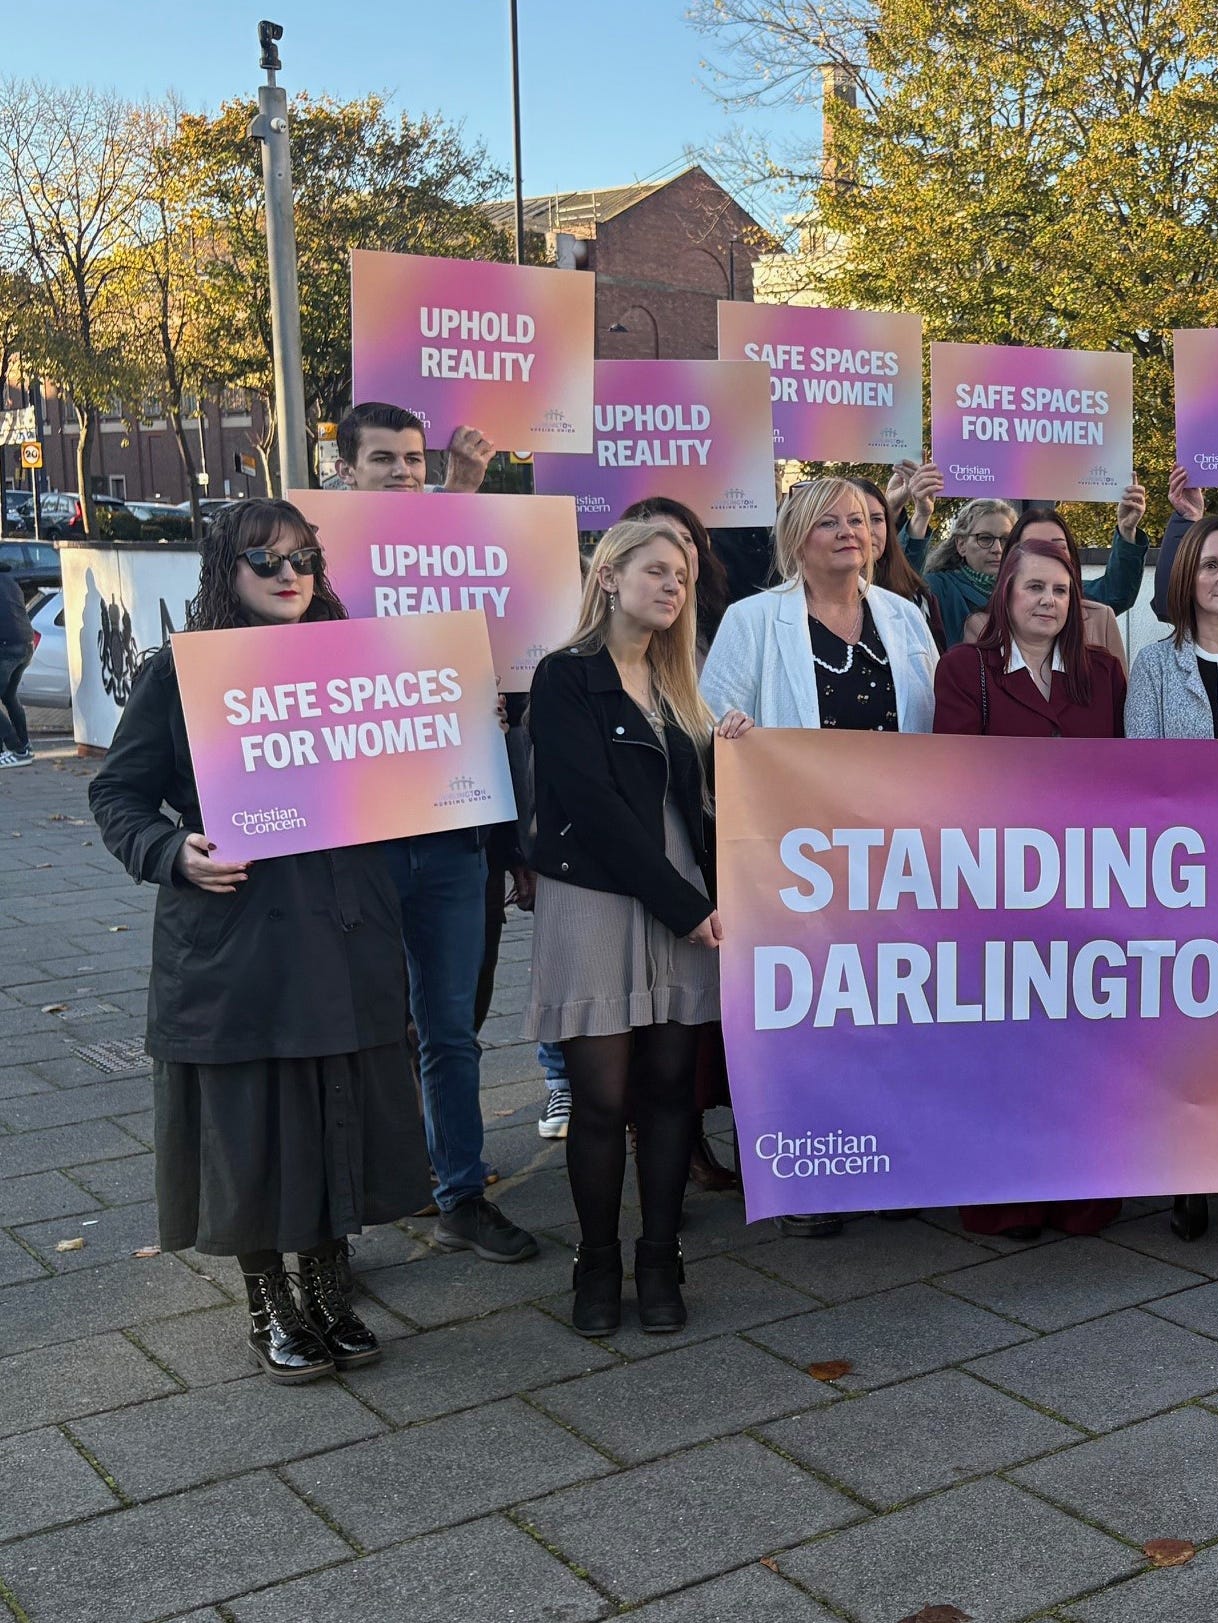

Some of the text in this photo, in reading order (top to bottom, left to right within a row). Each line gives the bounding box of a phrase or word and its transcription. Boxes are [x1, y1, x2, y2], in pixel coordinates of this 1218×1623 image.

[420, 307, 535, 344] UPHOLD
[421, 347, 535, 382] REALITY
[744, 343, 899, 376] SAFE SPACES
[770, 377, 893, 407] OR WOMEN
[956, 383, 1109, 415] SAFE SPACES
[594, 405, 711, 432] UPHOLD
[962, 415, 1103, 445] FOR WOMEN
[597, 439, 712, 467] REALITY
[949, 464, 990, 475] Christian
[955, 473, 995, 482] Concern
[576, 495, 605, 504] istian
[576, 503, 611, 513] oncern
[370, 544, 508, 577] UPHOLD
[375, 586, 511, 618] REALITY
[223, 667, 462, 726] SAFE SPACES
[240, 712, 461, 772] FOR WOMEN
[231, 807, 298, 827] Christian
[243, 816, 306, 836] Concern
[777, 825, 1207, 913] STANDING
[755, 1129, 877, 1159] Christian
[772, 1153, 890, 1179] Concern
